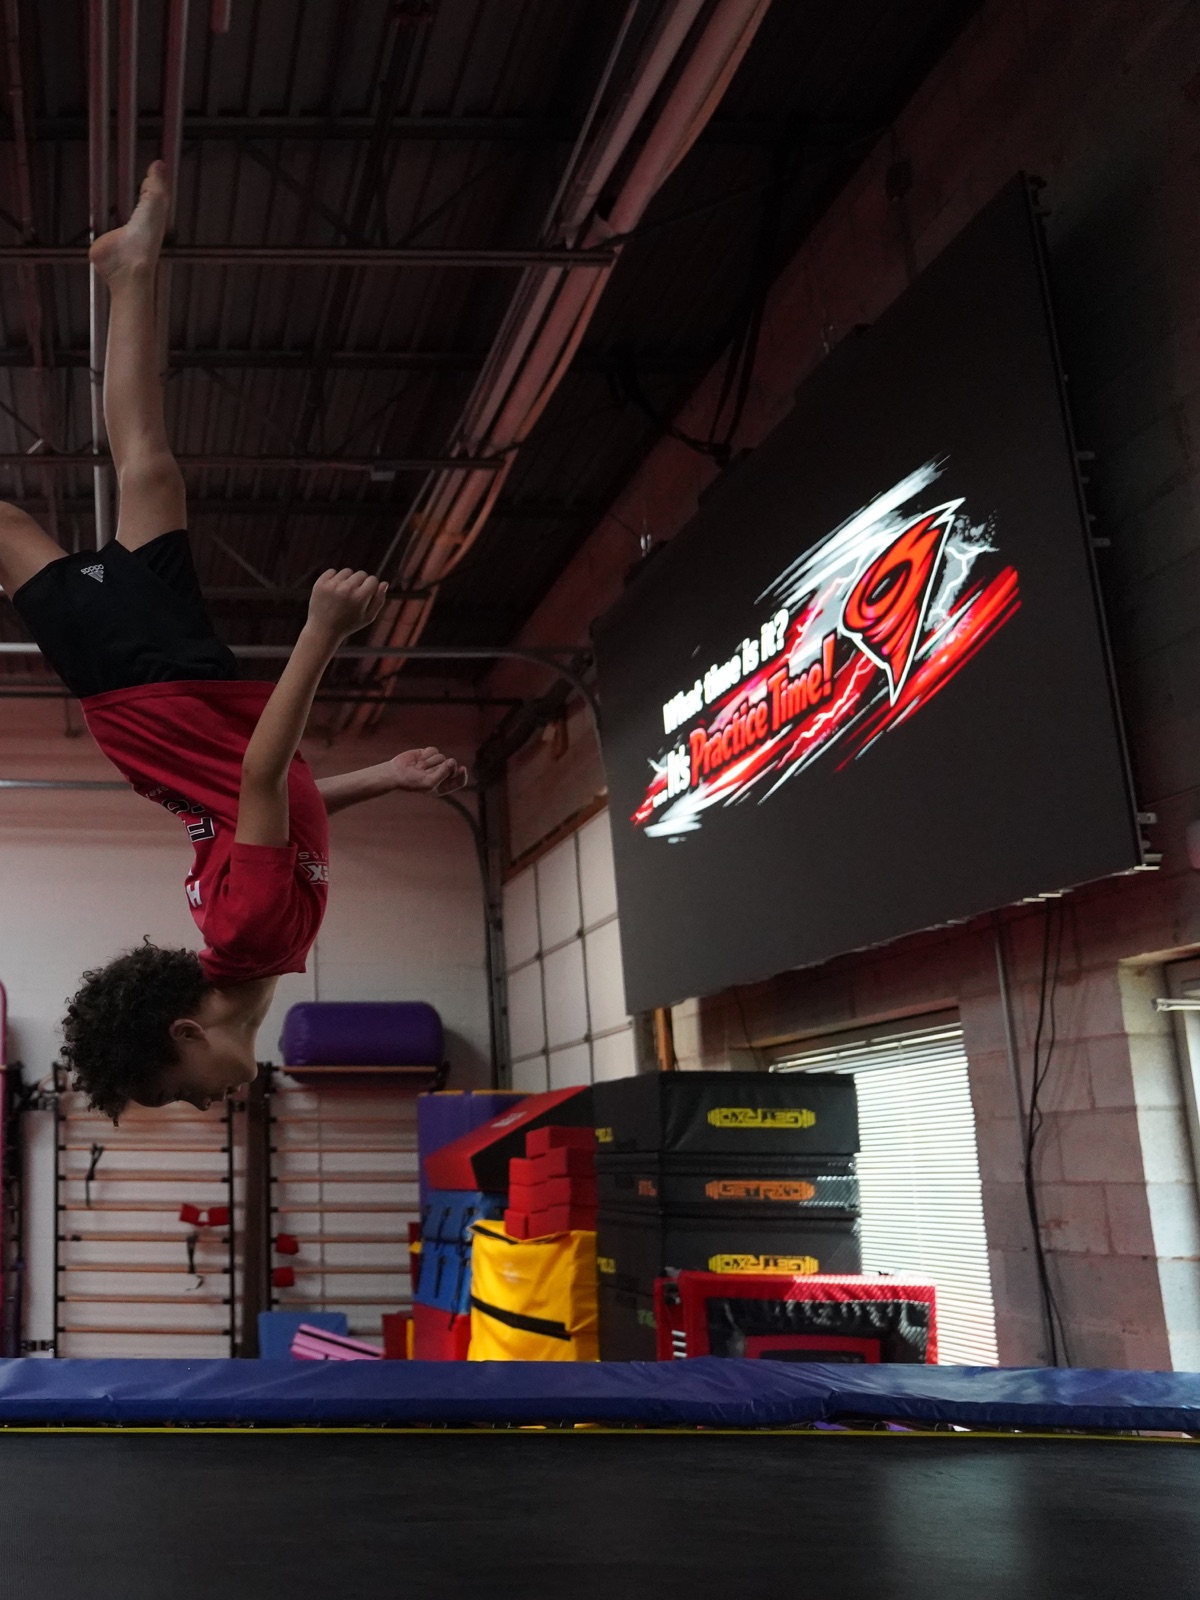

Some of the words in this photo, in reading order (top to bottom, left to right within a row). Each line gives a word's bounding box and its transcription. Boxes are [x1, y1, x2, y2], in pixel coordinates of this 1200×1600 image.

[663, 679, 704, 735] What
[703, 654, 742, 705] time
[742, 637, 760, 676] is
[760, 608, 790, 662] it?
[690, 700, 769, 787] Practice
[767, 633, 836, 731] Time!
